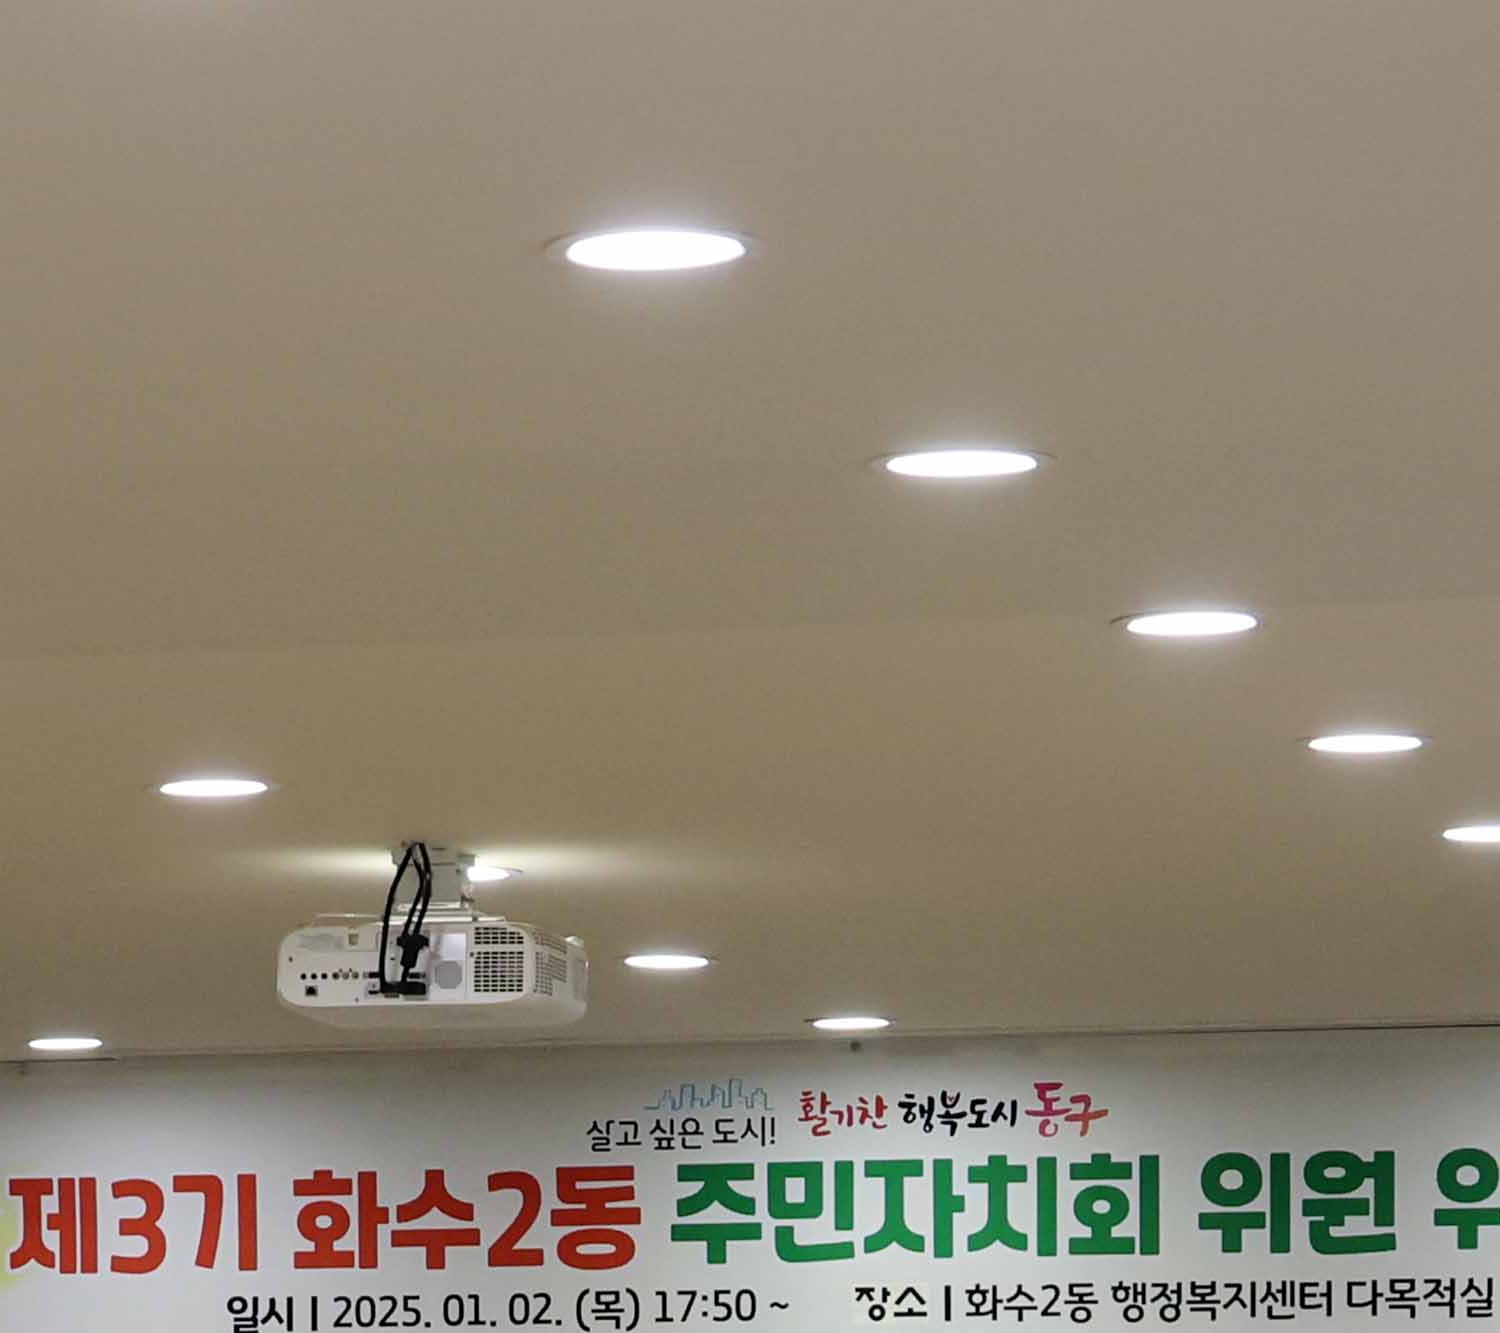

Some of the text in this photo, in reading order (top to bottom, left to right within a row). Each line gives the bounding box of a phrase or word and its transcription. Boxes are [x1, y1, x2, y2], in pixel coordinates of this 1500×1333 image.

[799, 1081, 1108, 1137] 활기찬 행복도시 동구
[586, 1116, 776, 1150] 살고 싶은 도시!
[8, 1175, 256, 1274] 제3기
[293, 1168, 641, 1270] 화수2동
[671, 1153, 1160, 1264] 주민자치회
[1199, 1150, 1397, 1256] 위원
[332, 1295, 432, 1329] 2025.
[442, 1294, 497, 1328] 01.
[507, 1292, 562, 1326] 02.
[576, 1287, 640, 1333] (목)
[653, 1289, 756, 1323] 17:50
[854, 1284, 929, 1323] 장소
[964, 1282, 1099, 1323] 화수2동
[1111, 1279, 1334, 1323] 행정복지센터
[1346, 1277, 1495, 1319] 다목적실
